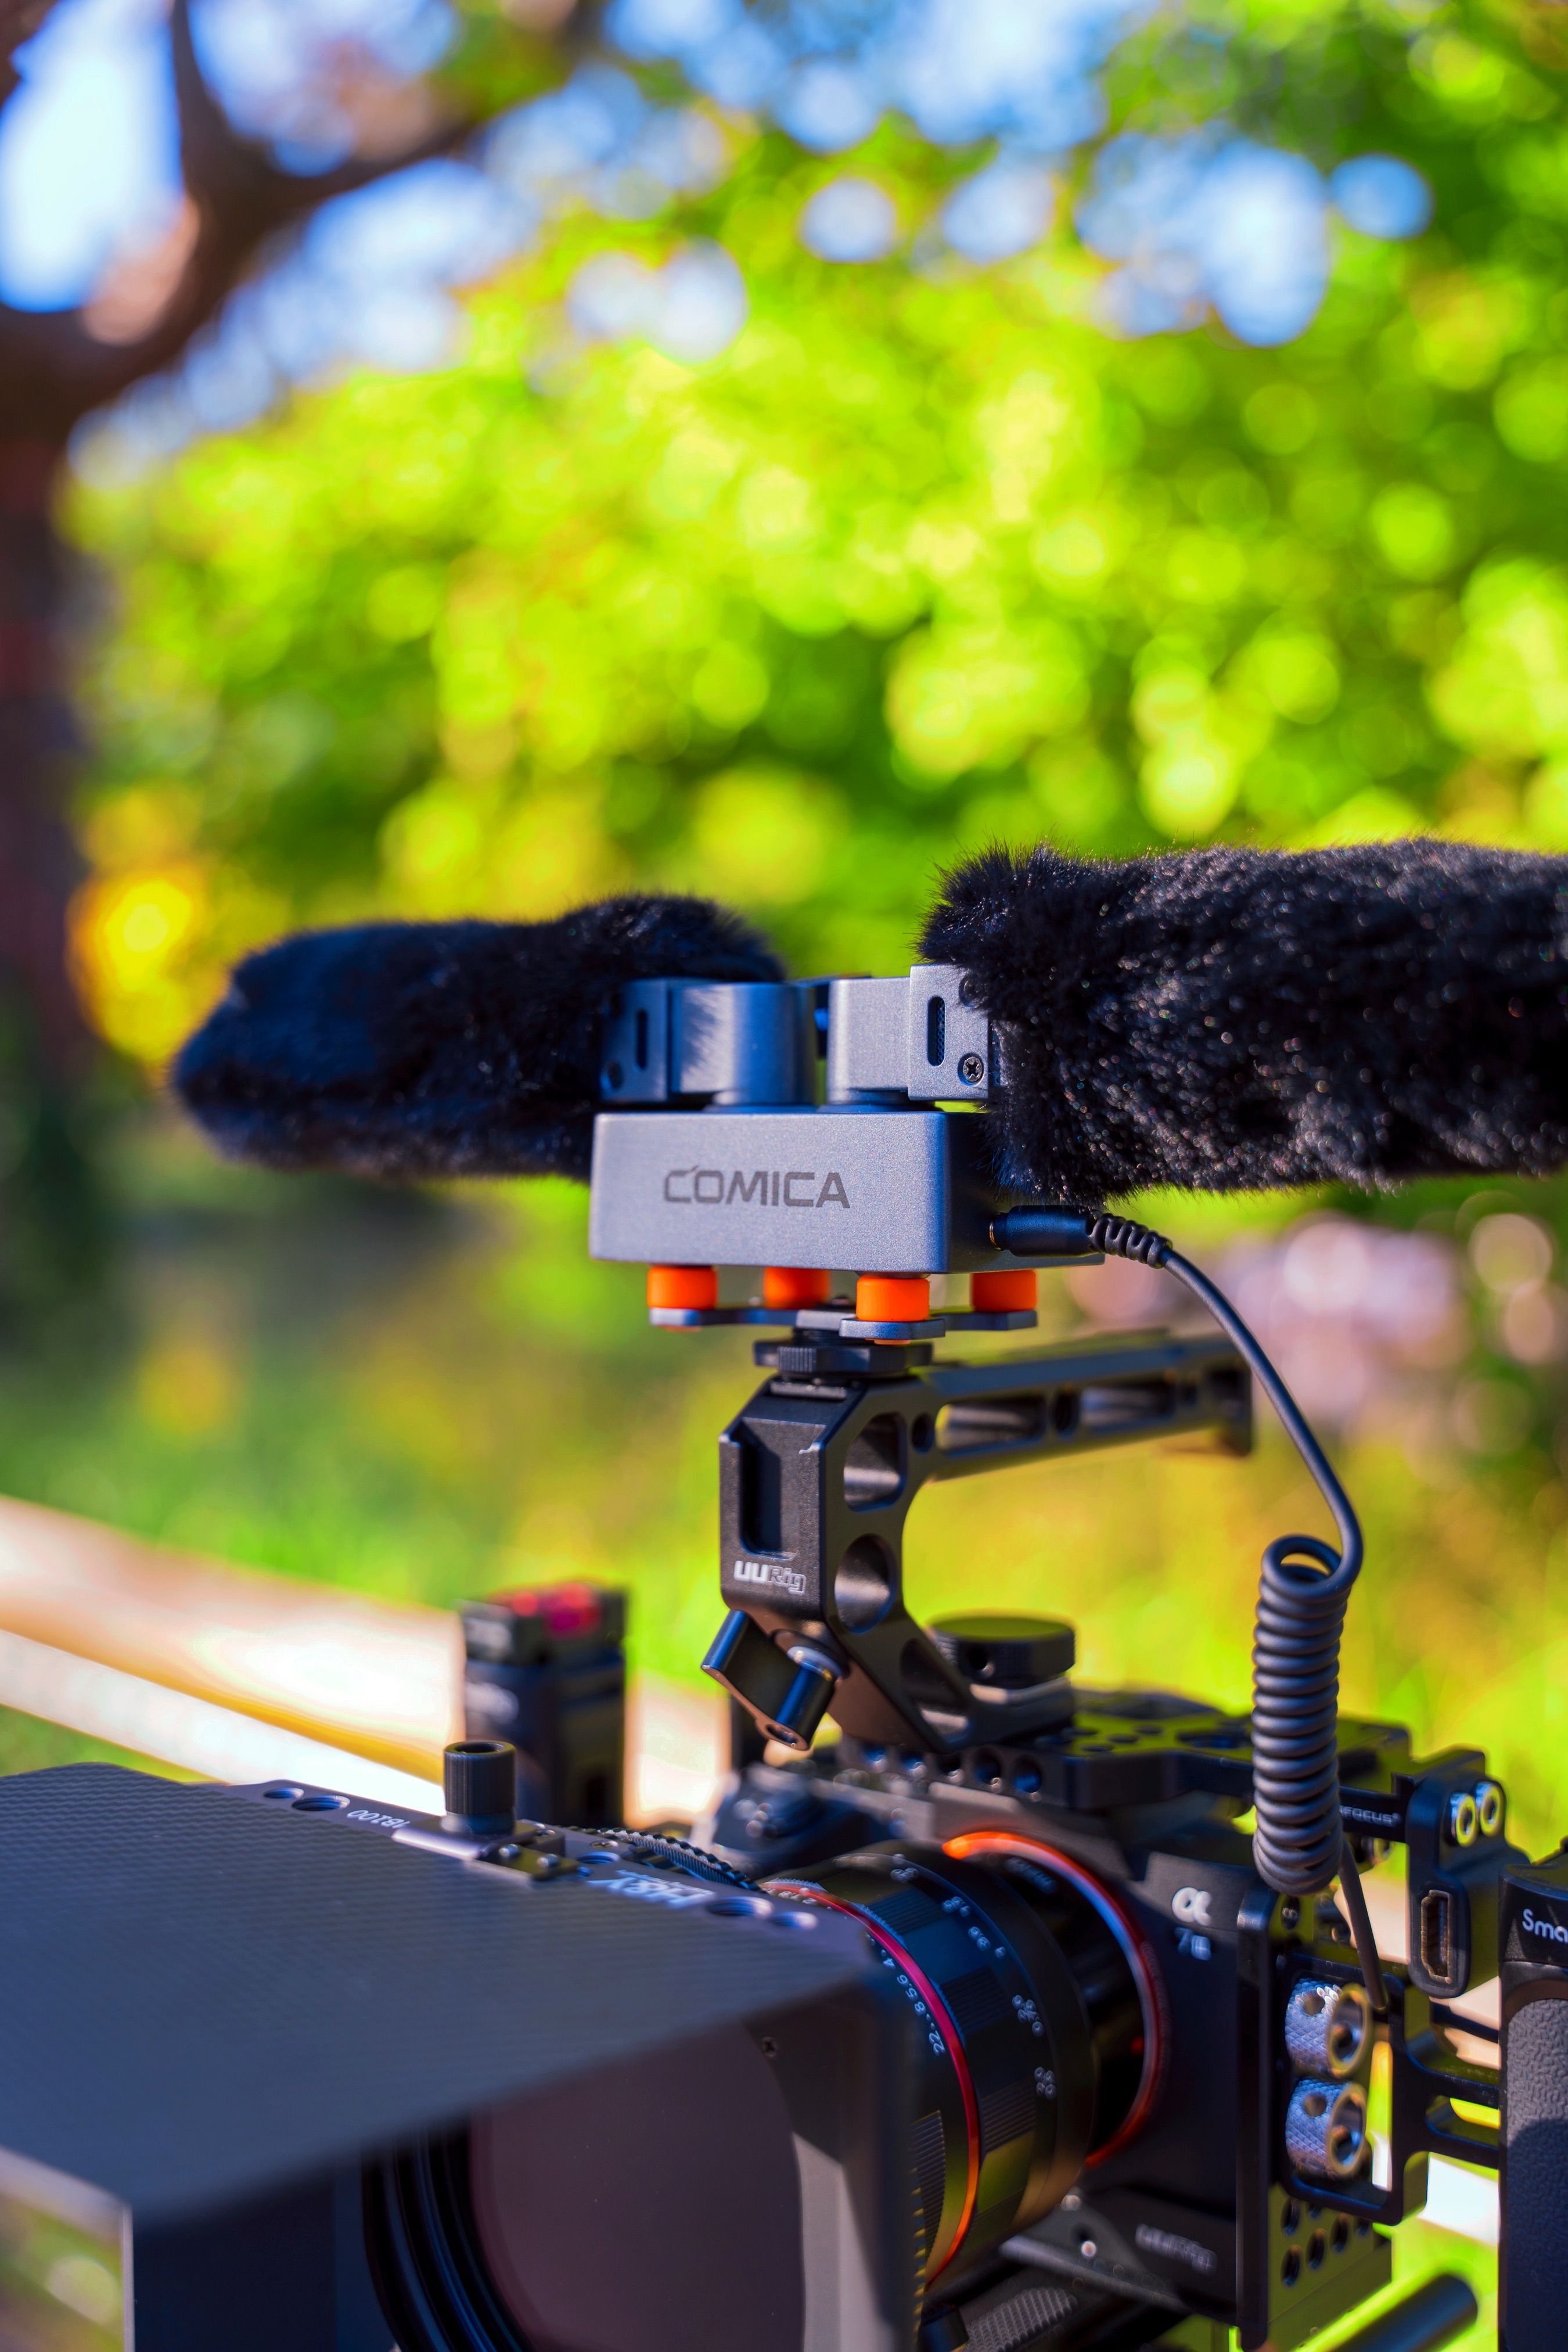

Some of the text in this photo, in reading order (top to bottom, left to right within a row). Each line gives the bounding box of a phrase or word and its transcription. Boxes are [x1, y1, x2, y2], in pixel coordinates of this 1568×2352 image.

[664, 1166, 850, 1209] COMICA
[1339, 1805, 1396, 1827] FOCUS
[883, 1958, 896, 1969] 4
[914, 2001, 926, 2016] 8
[929, 2030, 946, 2057] 22
